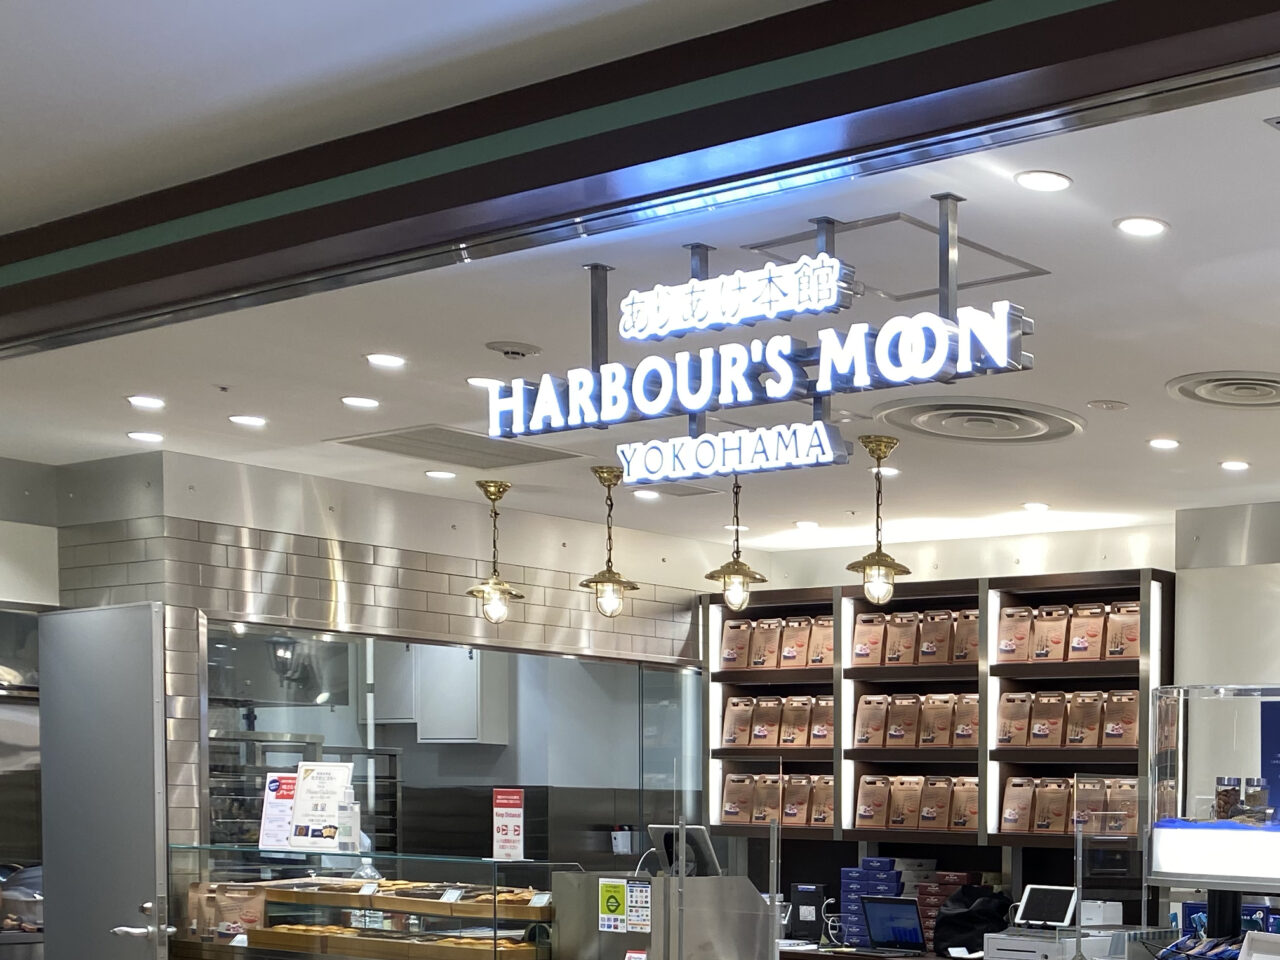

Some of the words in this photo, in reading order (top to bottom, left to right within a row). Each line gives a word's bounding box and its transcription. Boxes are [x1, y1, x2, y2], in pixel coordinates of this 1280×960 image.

[620, 254, 840, 339] ありあけ本館
[488, 333, 797, 437] HARBOUR'S
[817, 300, 1010, 392] MOON
[620, 423, 828, 481] YOKOHAMA
